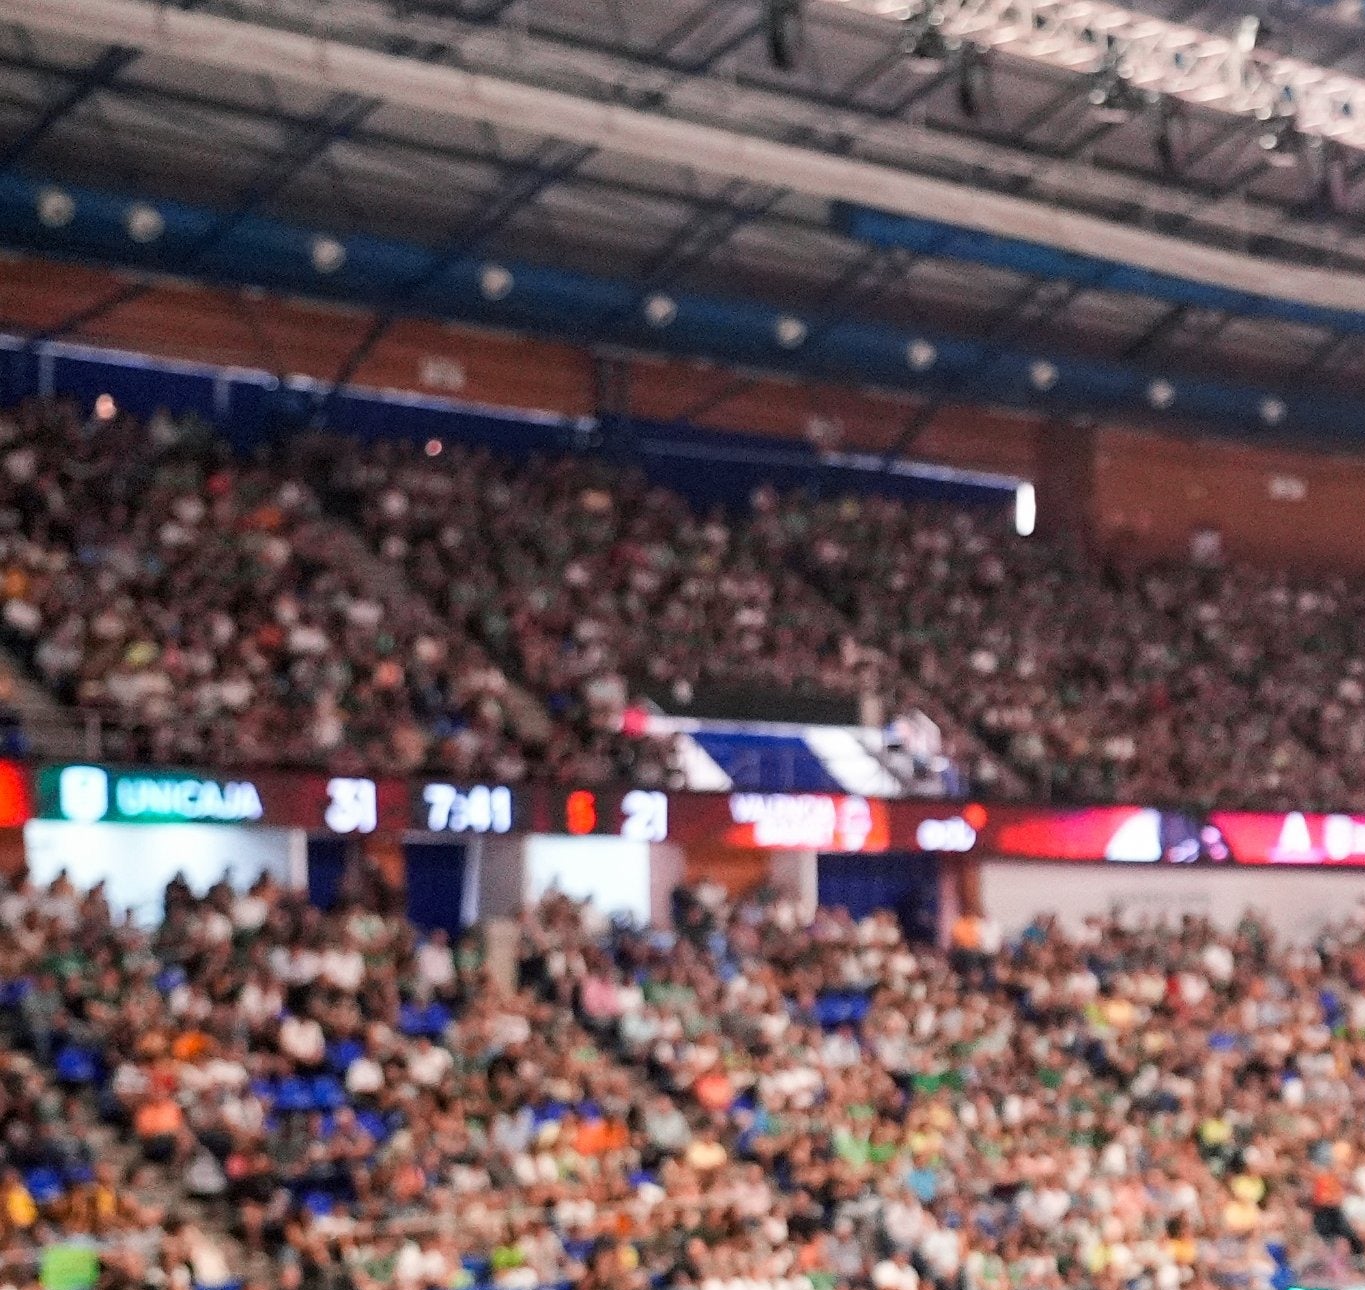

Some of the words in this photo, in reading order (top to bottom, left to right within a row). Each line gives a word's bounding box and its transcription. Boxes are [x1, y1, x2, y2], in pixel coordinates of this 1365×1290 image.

[115, 777, 264, 819] UNICAJA
[423, 783, 512, 833] 7:41
[620, 790, 668, 842] 21
